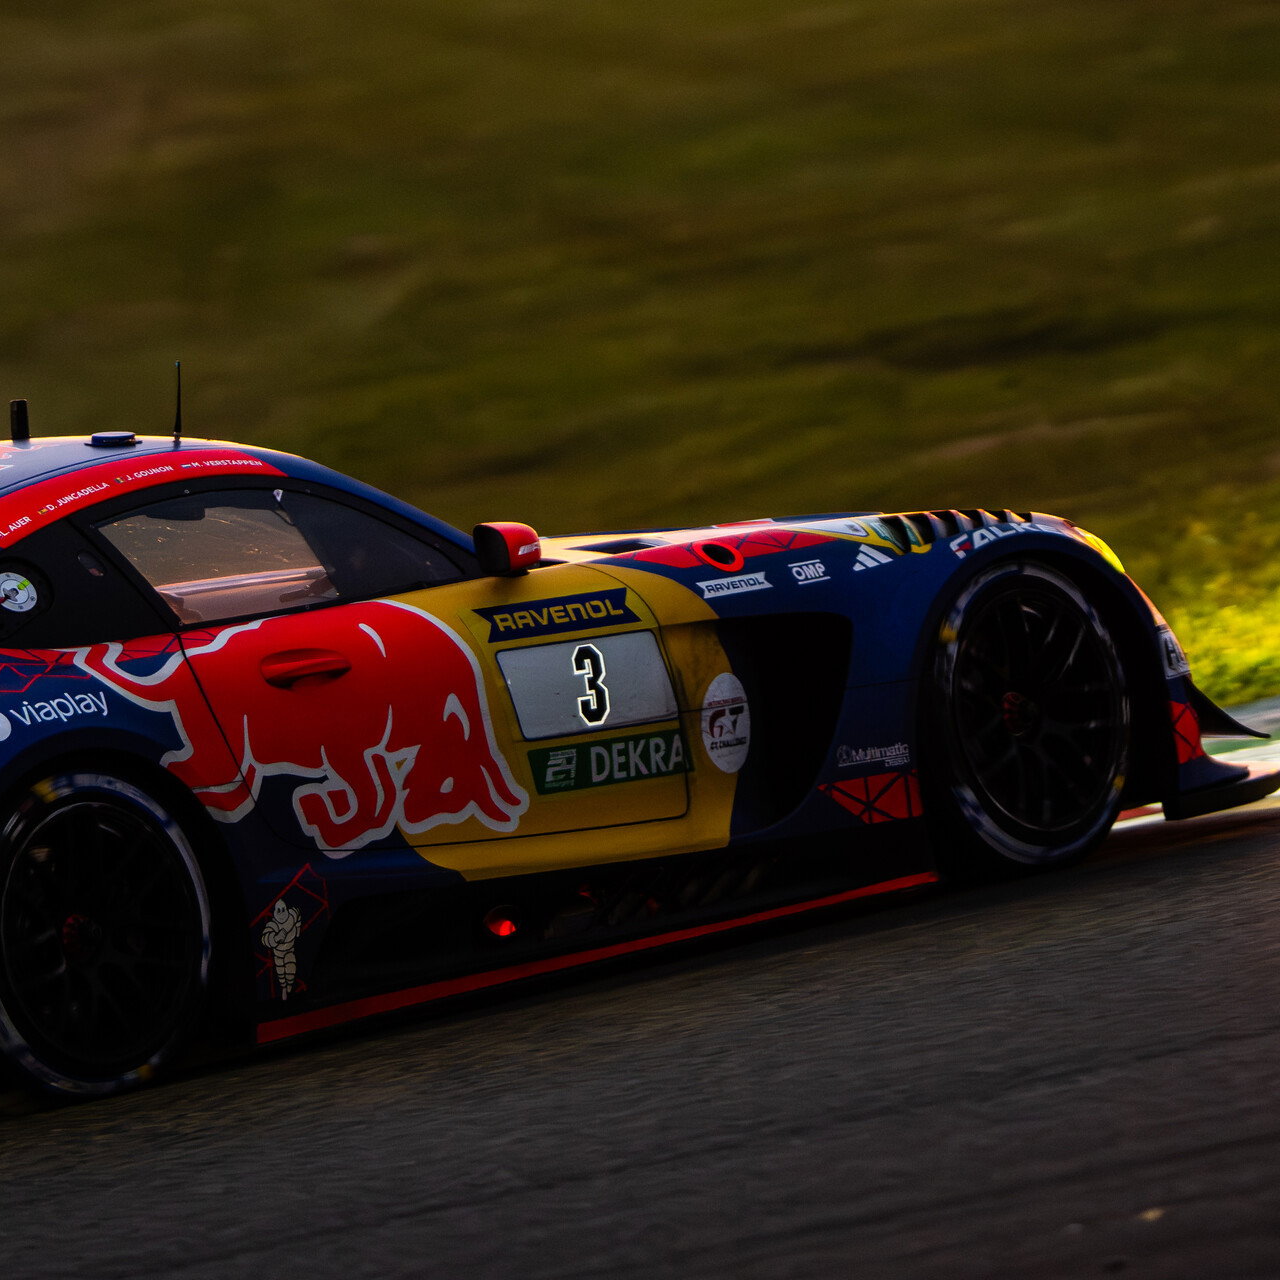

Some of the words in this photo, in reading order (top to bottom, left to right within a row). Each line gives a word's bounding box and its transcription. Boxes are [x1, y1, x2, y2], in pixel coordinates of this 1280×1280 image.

[134, 465, 174, 479] GOUNON
[203, 459, 263, 467] VERSTAPPEN
[58, 482, 110, 506] JUNCADELLA
[8, 516, 32, 531] AUER
[792, 563, 826, 581] OMP
[705, 575, 765, 594] RAVENOL
[493, 599, 624, 632] RAVENOL
[572, 643, 611, 726] 3
[9, 691, 108, 726] viaplay
[590, 733, 689, 783] DEKRA
